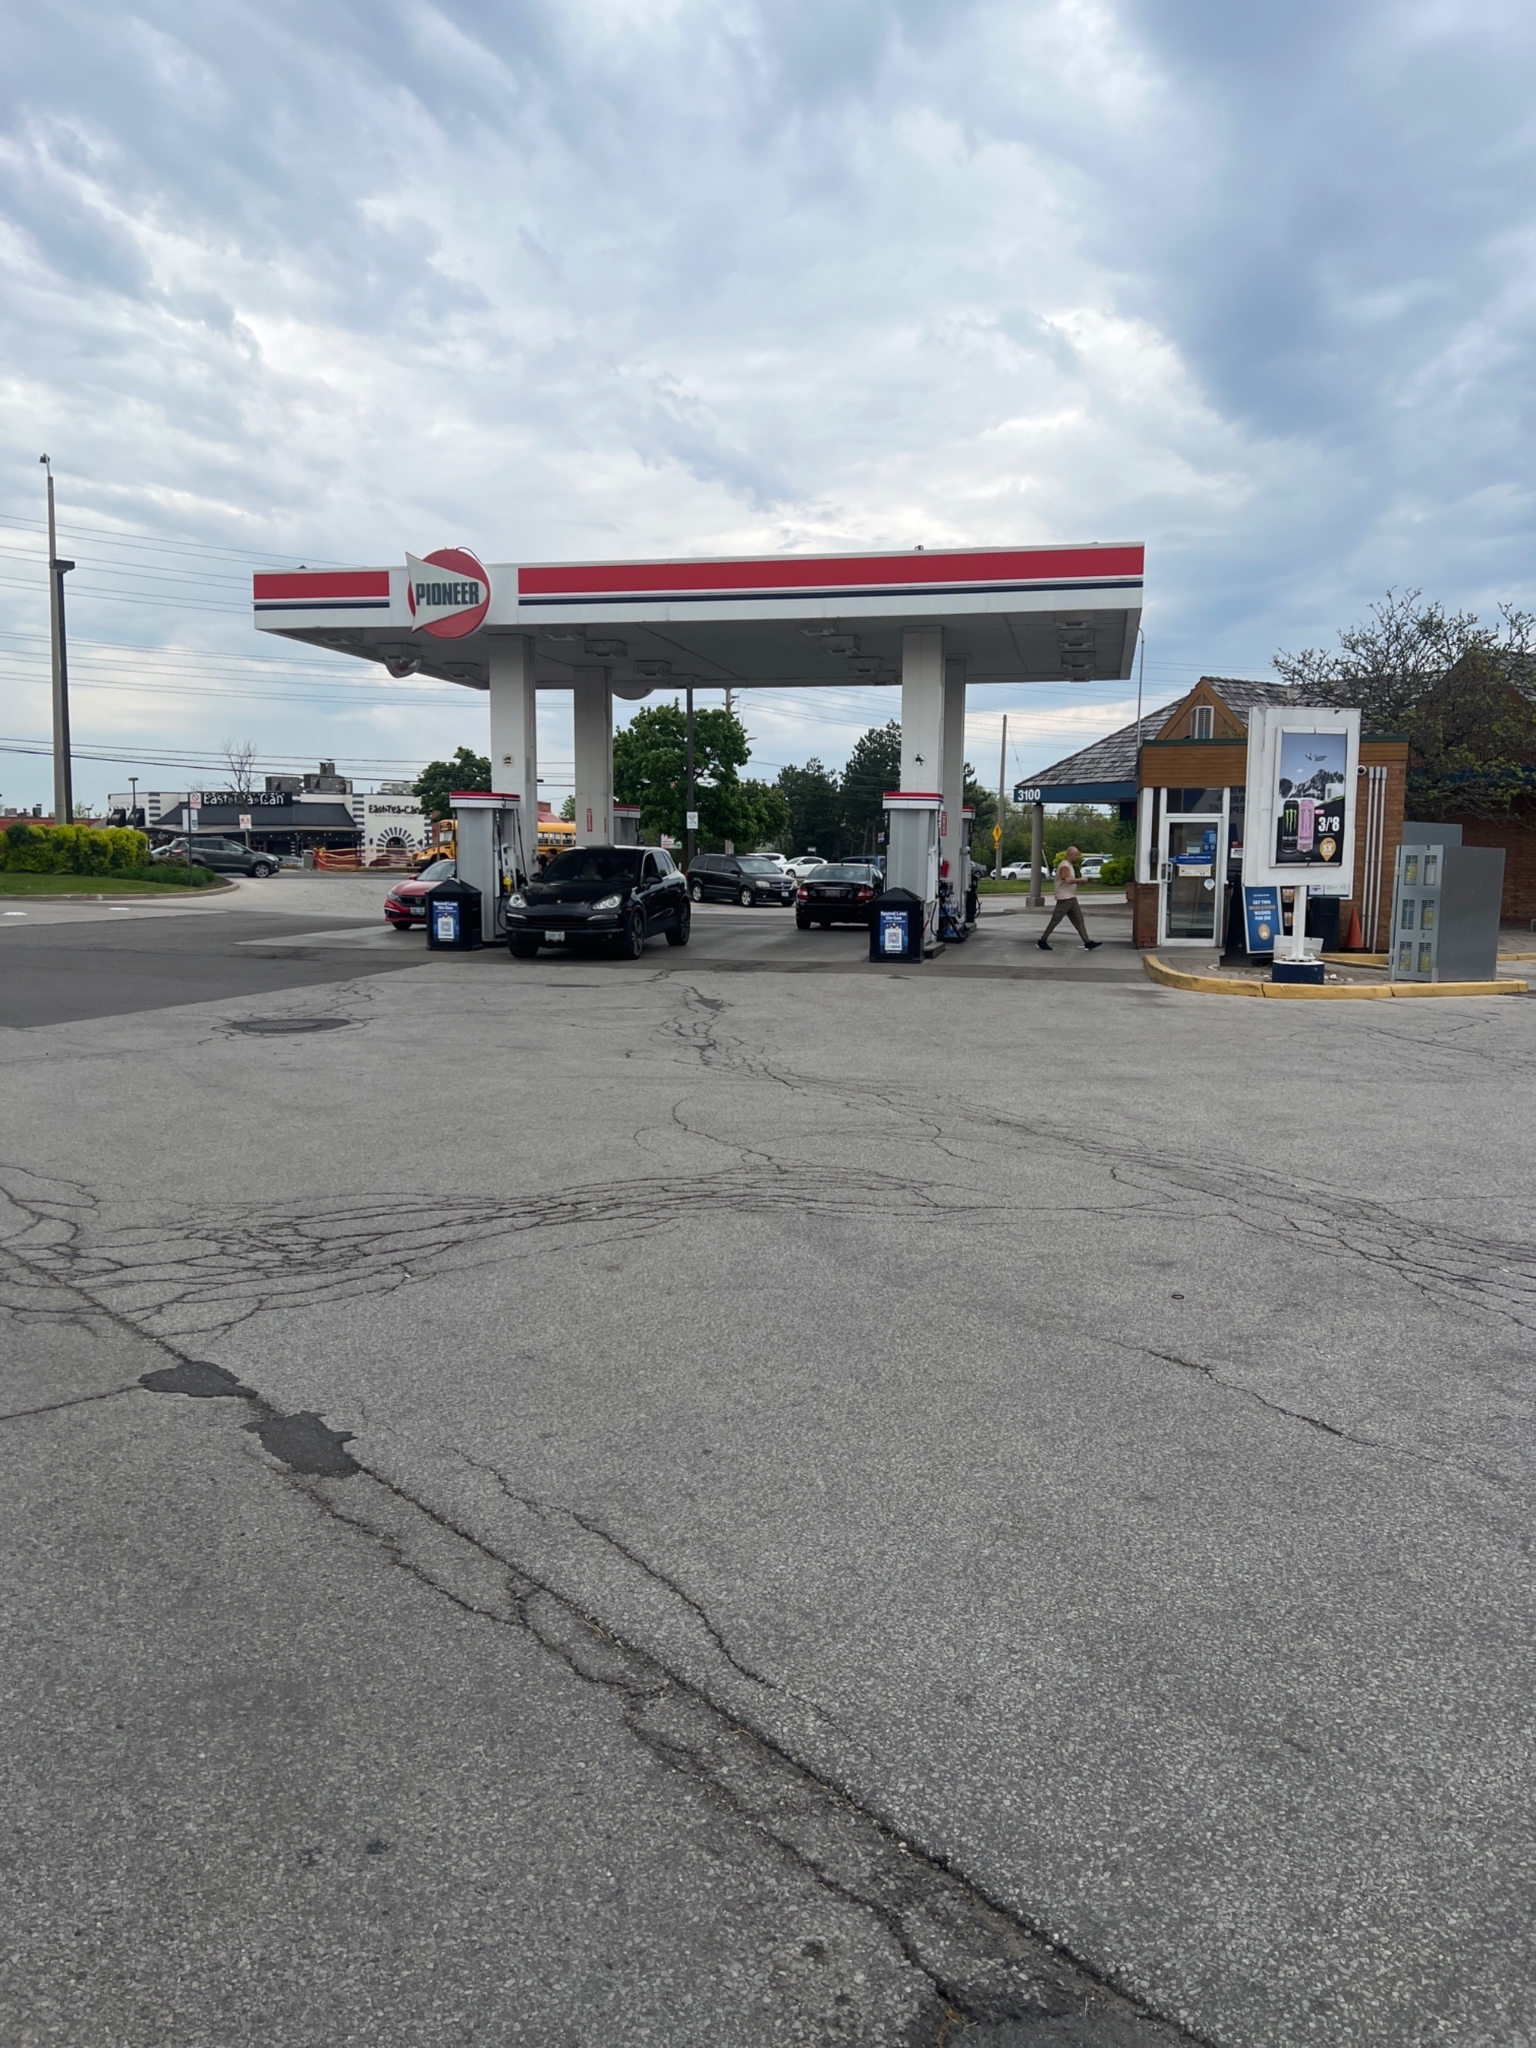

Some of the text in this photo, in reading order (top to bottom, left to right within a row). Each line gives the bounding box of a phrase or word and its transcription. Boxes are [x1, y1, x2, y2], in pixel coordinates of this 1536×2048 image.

[416, 582, 479, 606] PIONEER
[203, 792, 228, 805] East
[260, 793, 285, 805] Can
[1017, 788, 1041, 801] 3100
[368, 804, 386, 814] East
[387, 805, 402, 815] Tea
